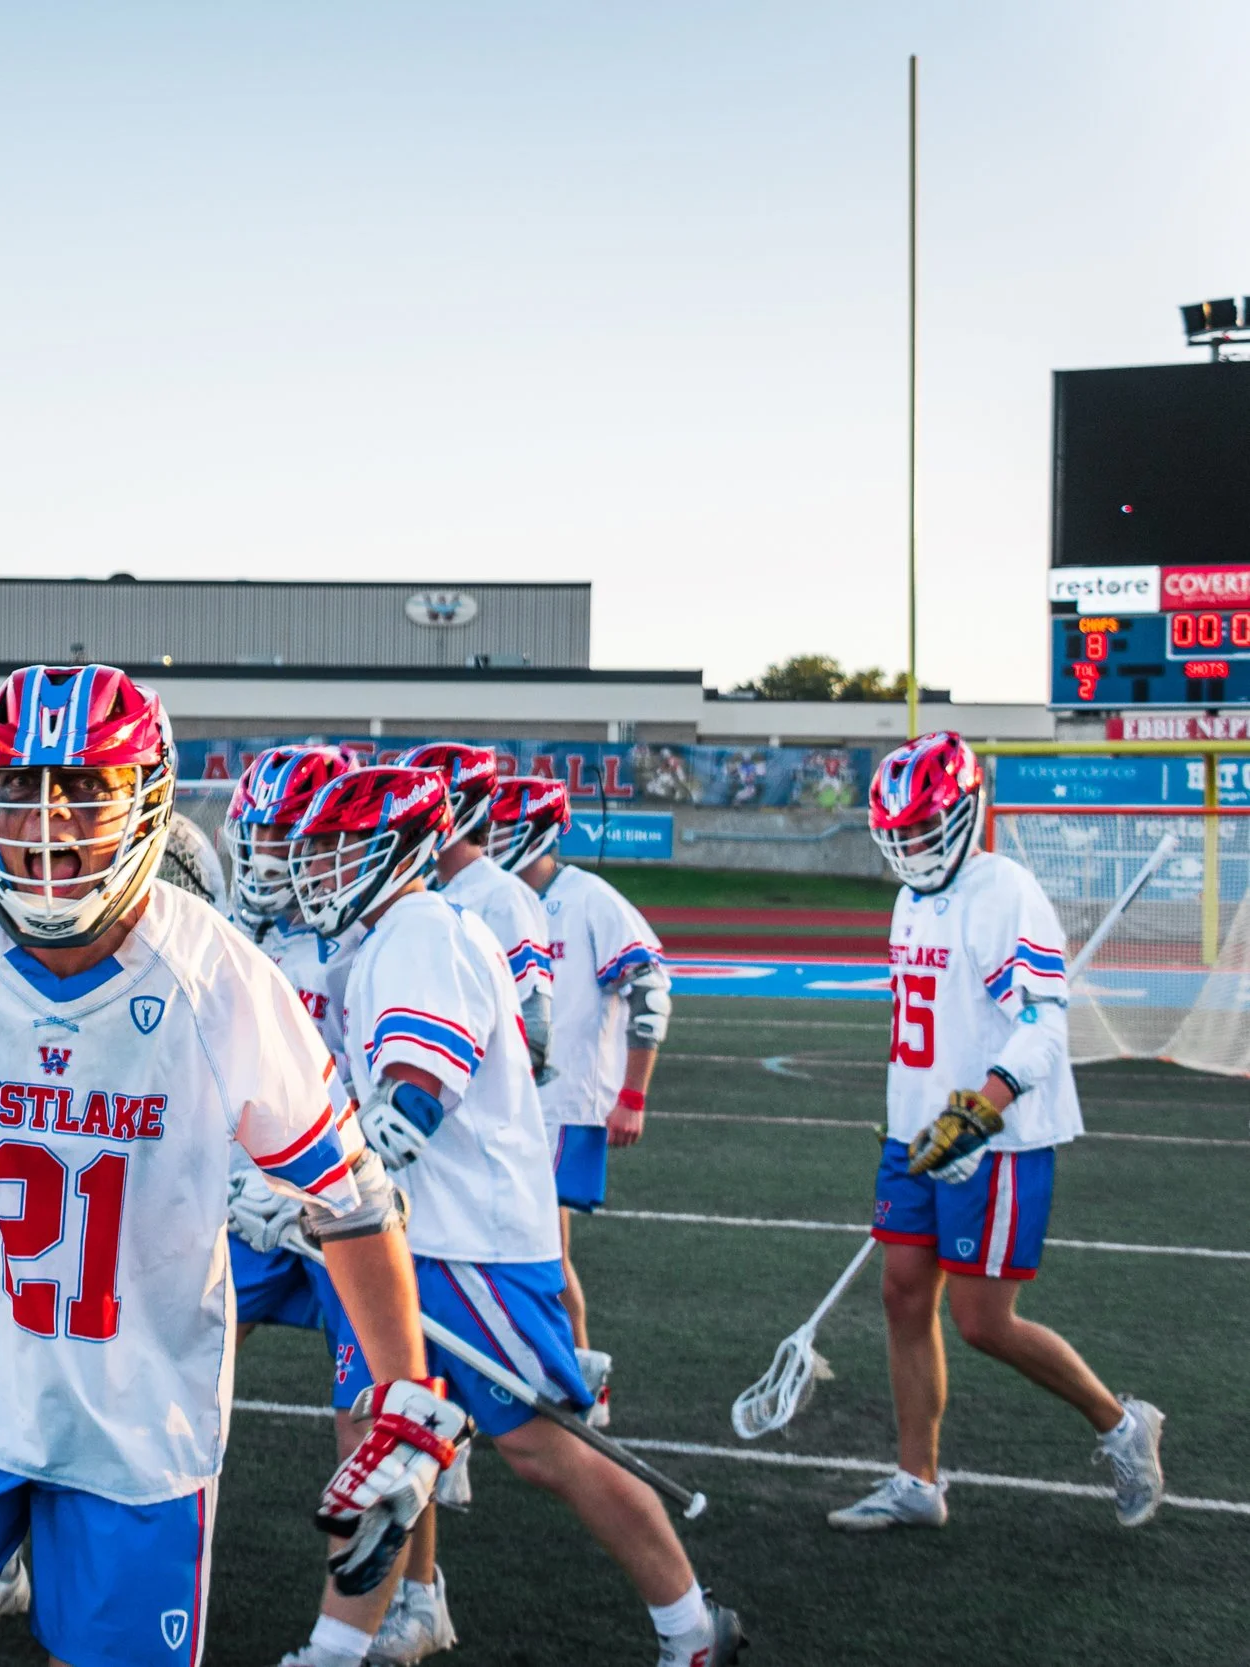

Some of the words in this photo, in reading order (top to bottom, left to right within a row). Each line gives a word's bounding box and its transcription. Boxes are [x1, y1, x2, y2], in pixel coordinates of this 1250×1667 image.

[1056, 577, 1150, 595] restore
[1165, 572, 1250, 596] COVERT
[1086, 632, 1107, 661] 8
[1184, 661, 1230, 678] SHOTS
[1078, 679, 1095, 700] 2
[1123, 718, 1188, 740] EBBIE
[1196, 718, 1250, 740] NEP
